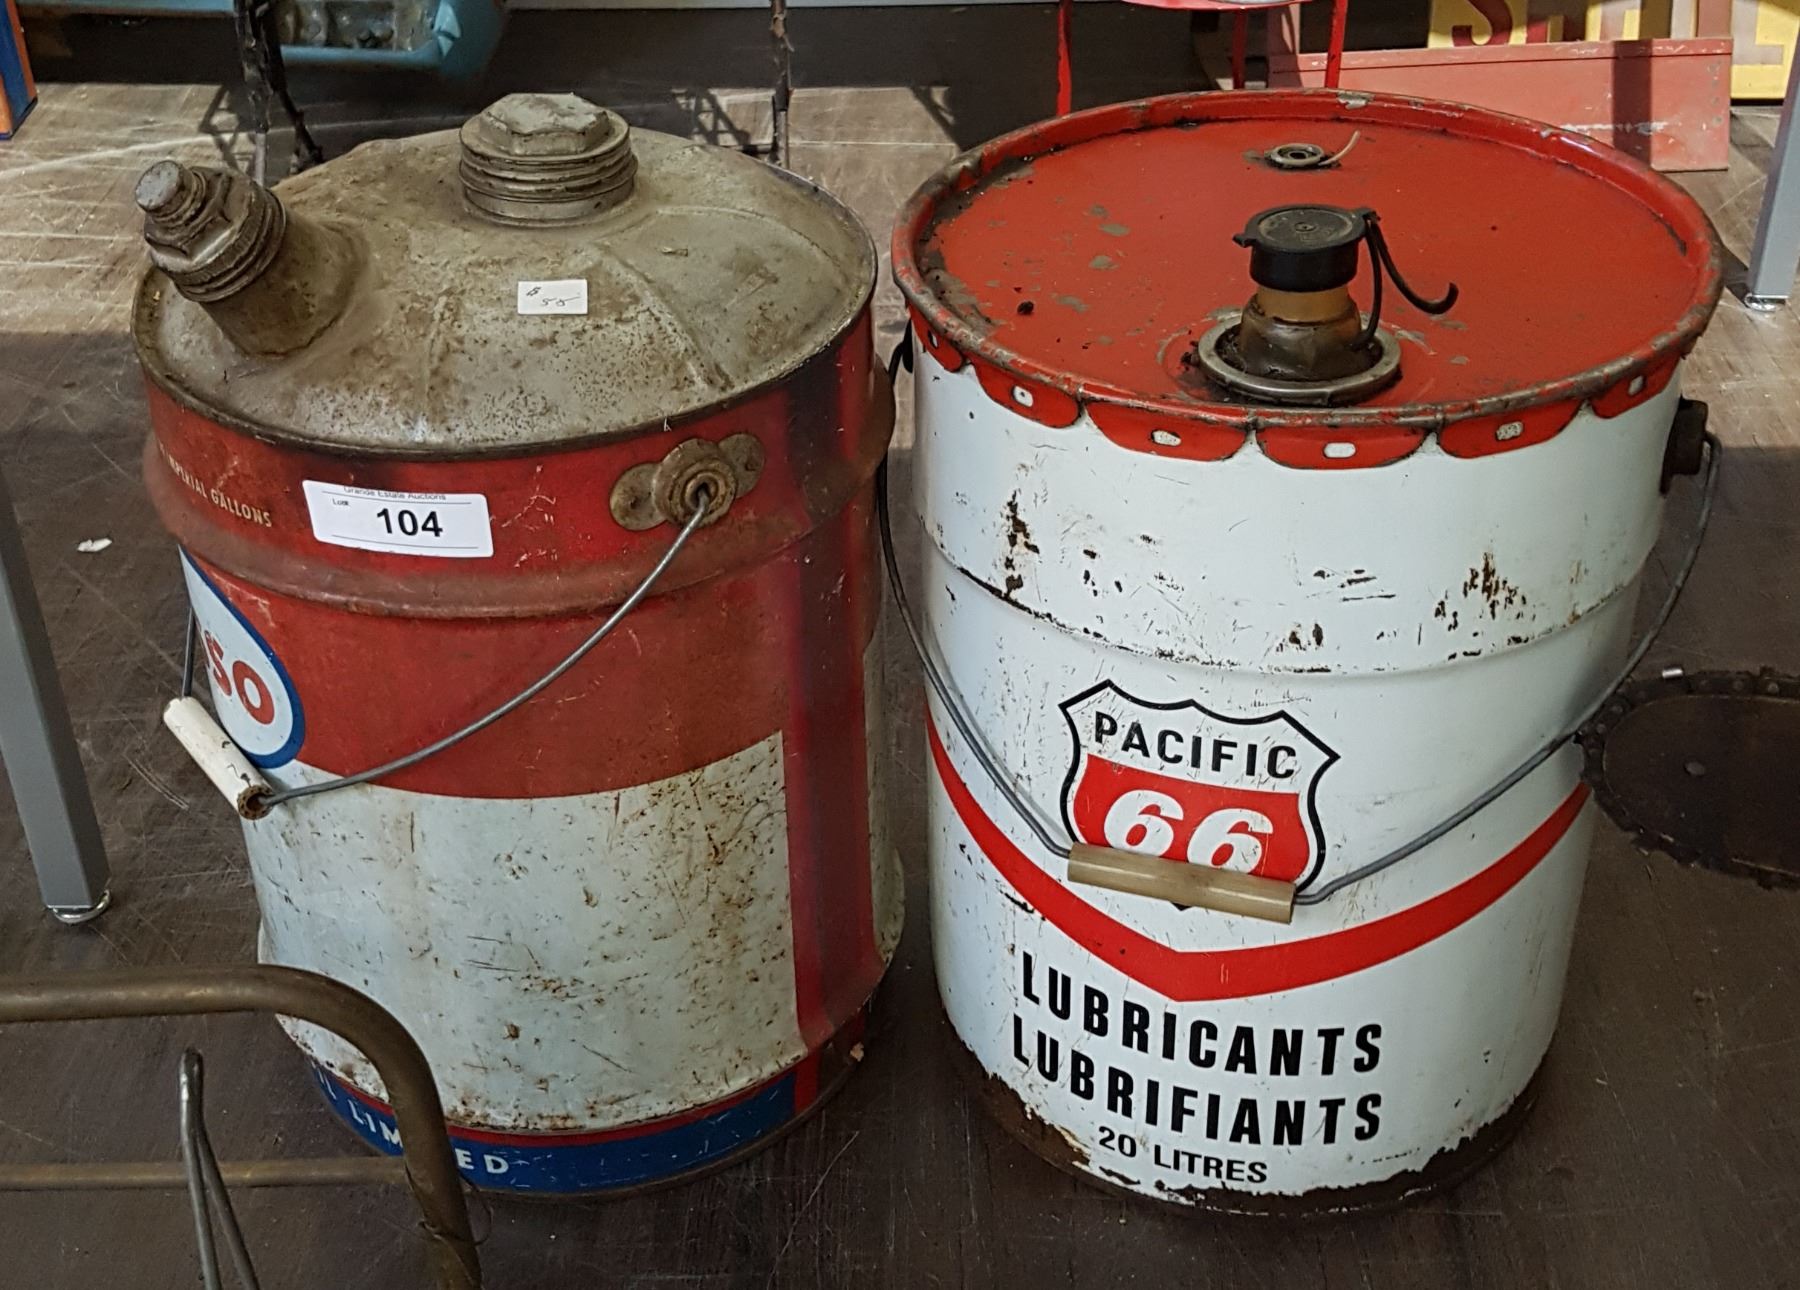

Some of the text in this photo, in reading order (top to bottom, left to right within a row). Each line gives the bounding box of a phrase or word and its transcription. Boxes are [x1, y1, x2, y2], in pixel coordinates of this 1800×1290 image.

[210, 488, 272, 528] GALLONS
[377, 507, 443, 537] 104
[1093, 710, 1297, 779] PACIFIC
[1103, 788, 1274, 875] 66
[1022, 950, 1383, 1077] LUBRICANTS
[1012, 1012, 1383, 1146] LUBRIFIANTS
[347, 1099, 510, 1175] LIMED
[1099, 1125, 1268, 1184] 20 LITRES
